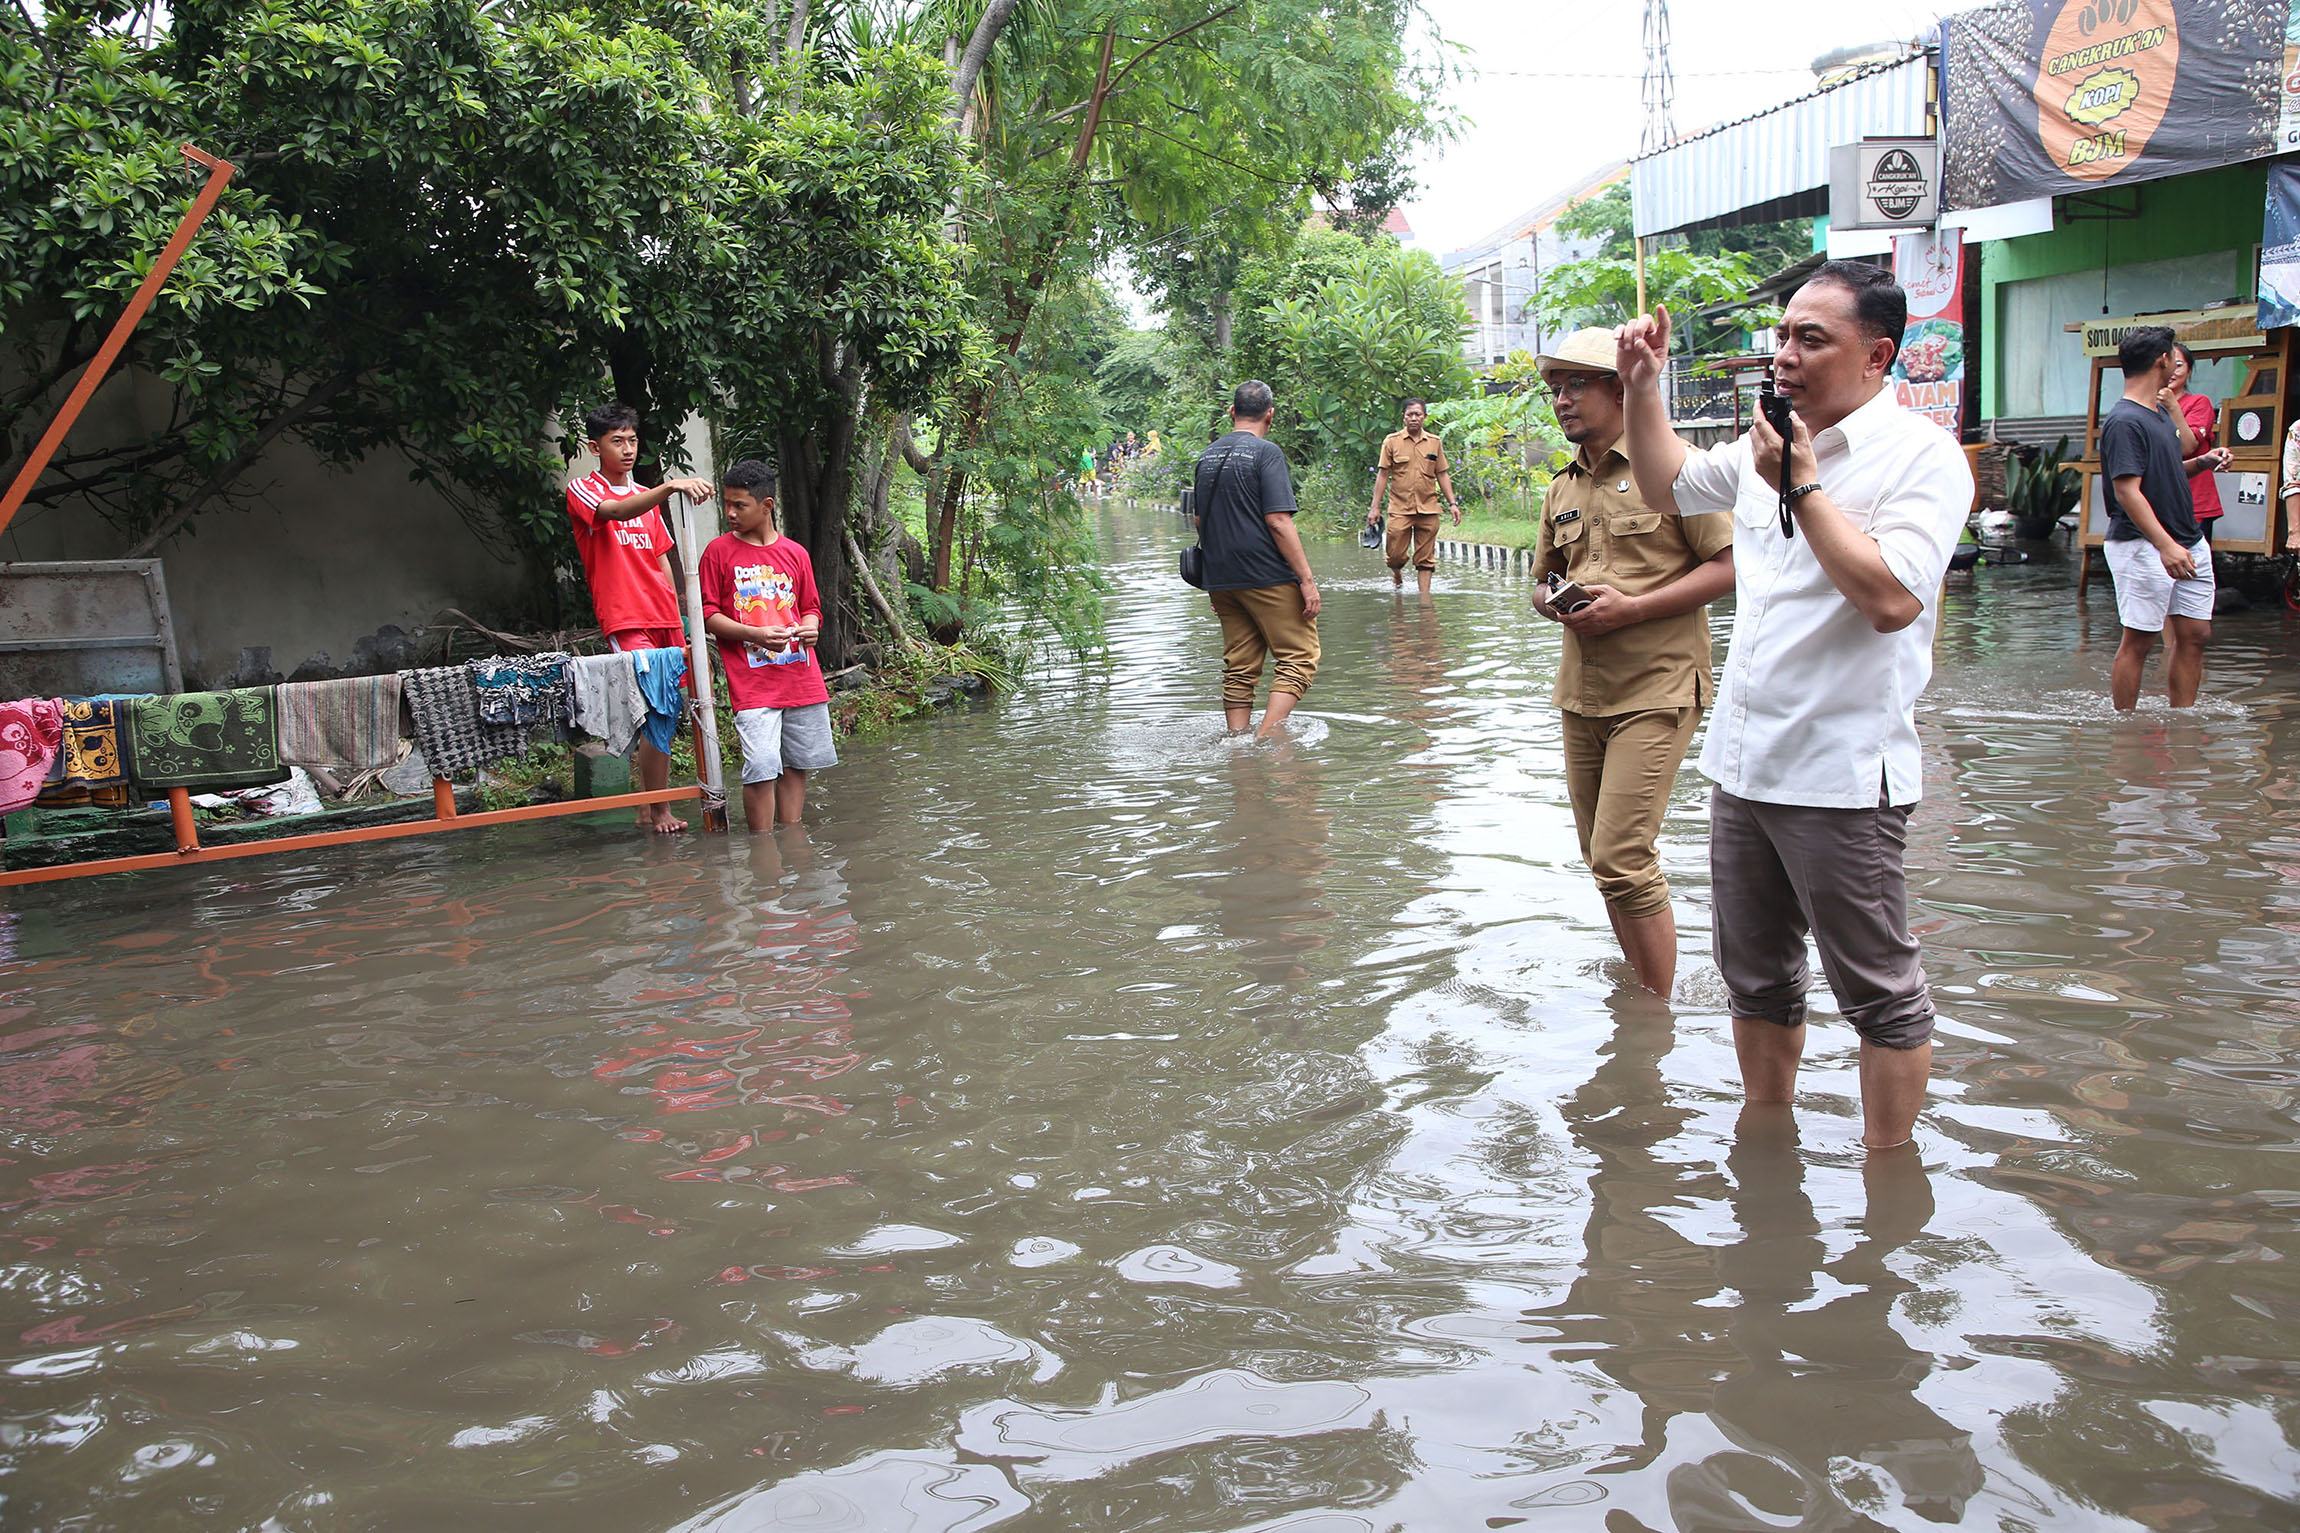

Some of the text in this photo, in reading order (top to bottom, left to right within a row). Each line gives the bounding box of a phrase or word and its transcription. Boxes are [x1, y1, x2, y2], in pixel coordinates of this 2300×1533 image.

[2048, 25, 2167, 76] CANGKRUK'AN
[2079, 82, 2123, 111] KOPI
[2068, 129, 2127, 166] BJM
[1888, 198, 1906, 209] BJM
[2087, 328, 2110, 348] SOTO
[1897, 380, 1959, 409] AYAM
